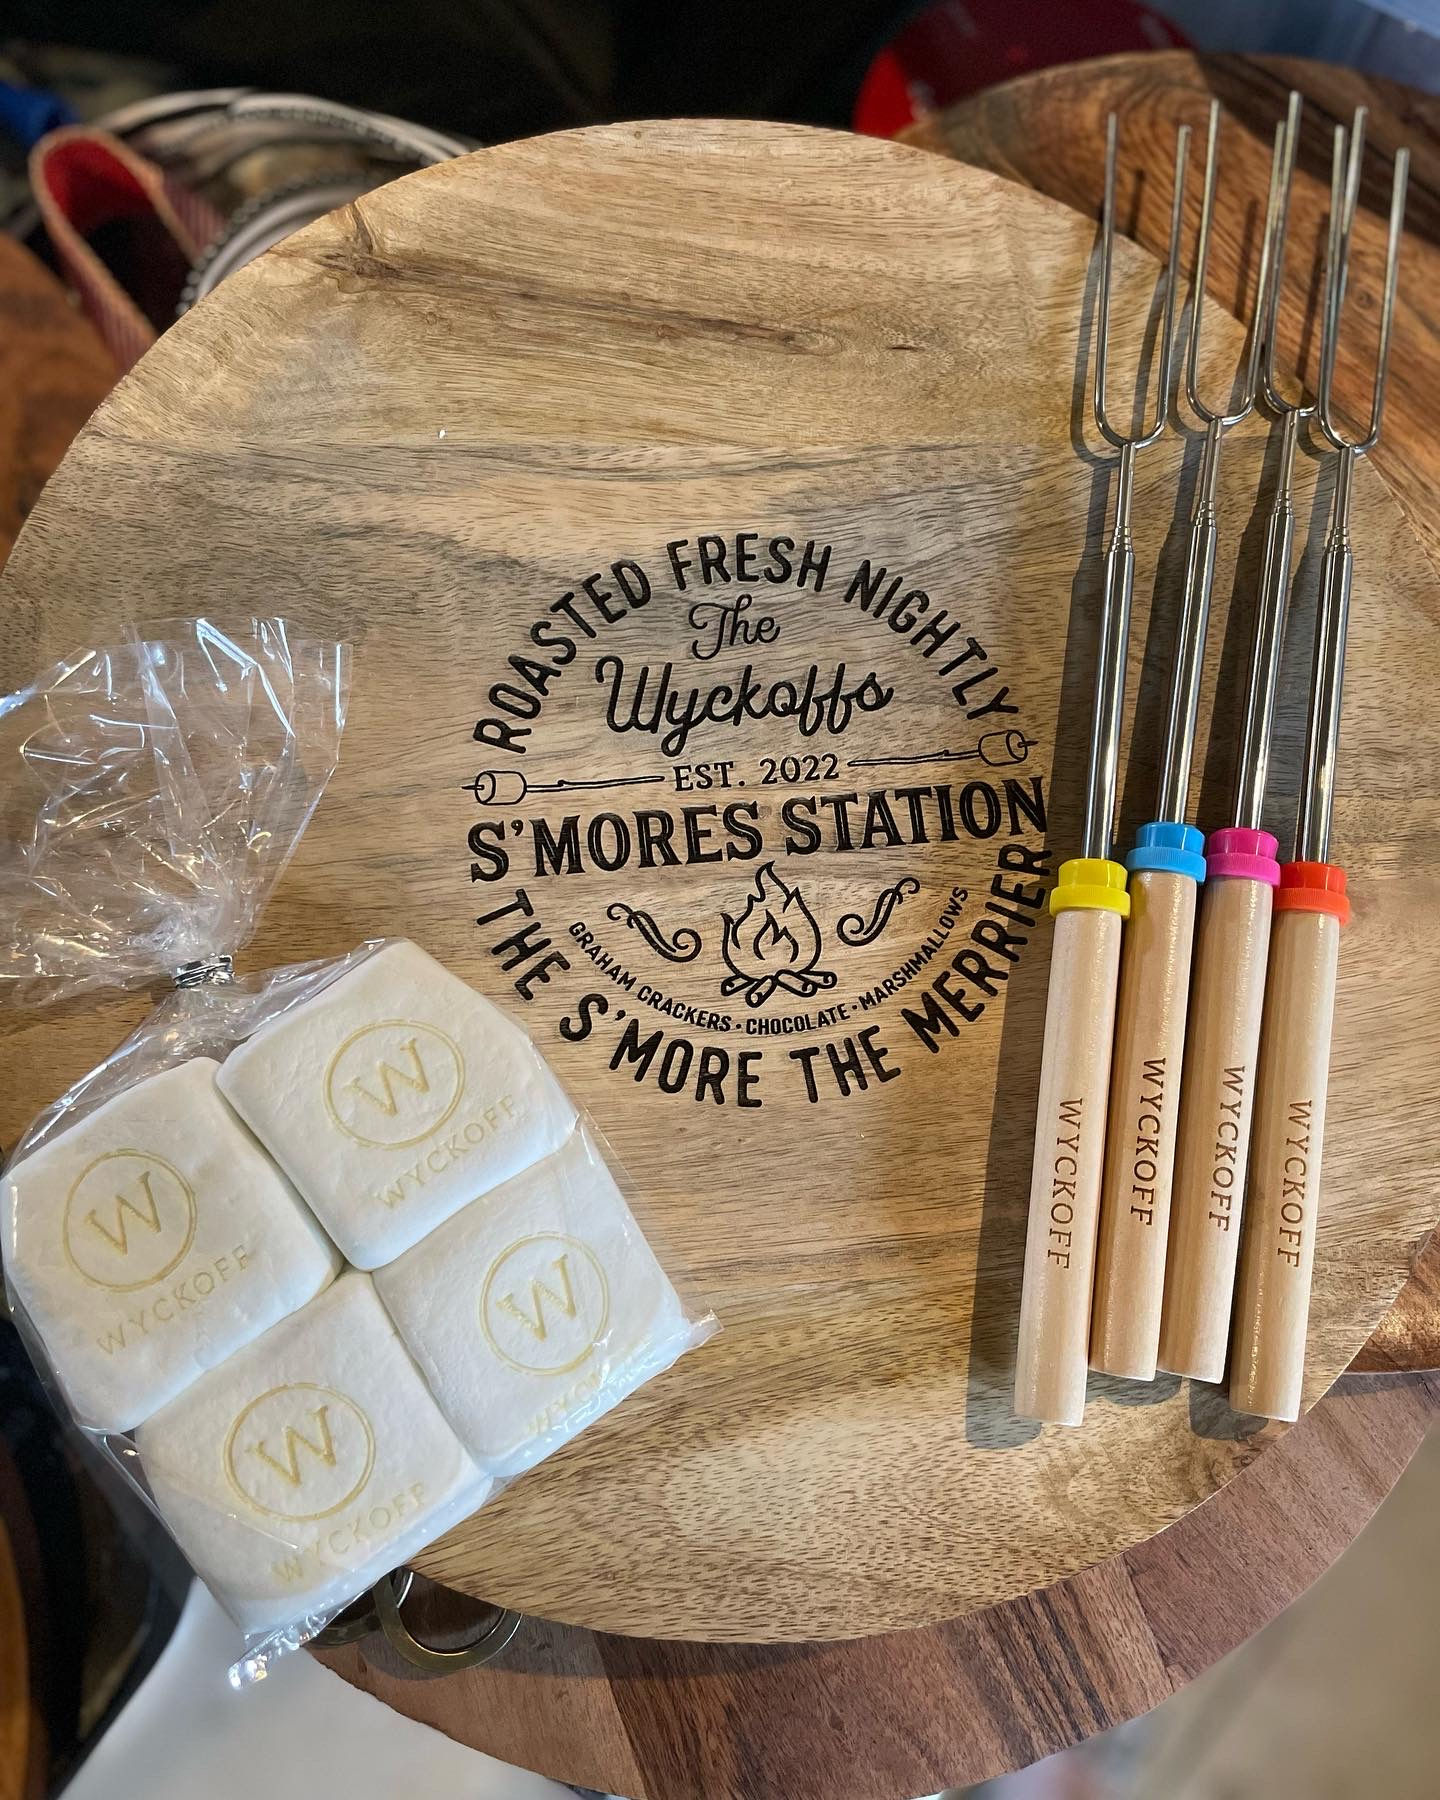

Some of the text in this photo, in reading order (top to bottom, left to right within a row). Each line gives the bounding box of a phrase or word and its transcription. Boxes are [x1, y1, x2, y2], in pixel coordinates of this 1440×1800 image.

[473, 532, 1019, 754] ROASTED FRESH NIGHTLY
[688, 594, 781, 660] The
[595, 655, 894, 757] Wyckoffs
[673, 753, 839, 791] EST. 2022
[468, 776, 1047, 883] S'MORES STATION
[476, 844, 1053, 1109] THE S'MORE THE MERRIER
[569, 886, 968, 1036] GRAHAM CRACKERS CHOCOLATE MARSHMALLOWS
[342, 1037, 430, 1117] W
[374, 1093, 516, 1211] WYCKOFF
[1048, 1098, 1083, 1269] WYCKOFF
[1130, 1057, 1166, 1226] WYCKOFF
[1209, 1066, 1246, 1232] WYCKOFF
[1277, 1100, 1312, 1268] WYCKOFF
[84, 1171, 161, 1257] W
[97, 1244, 251, 1356] WYCKOFF
[497, 1253, 577, 1342] W
[244, 1405, 337, 1488] W
